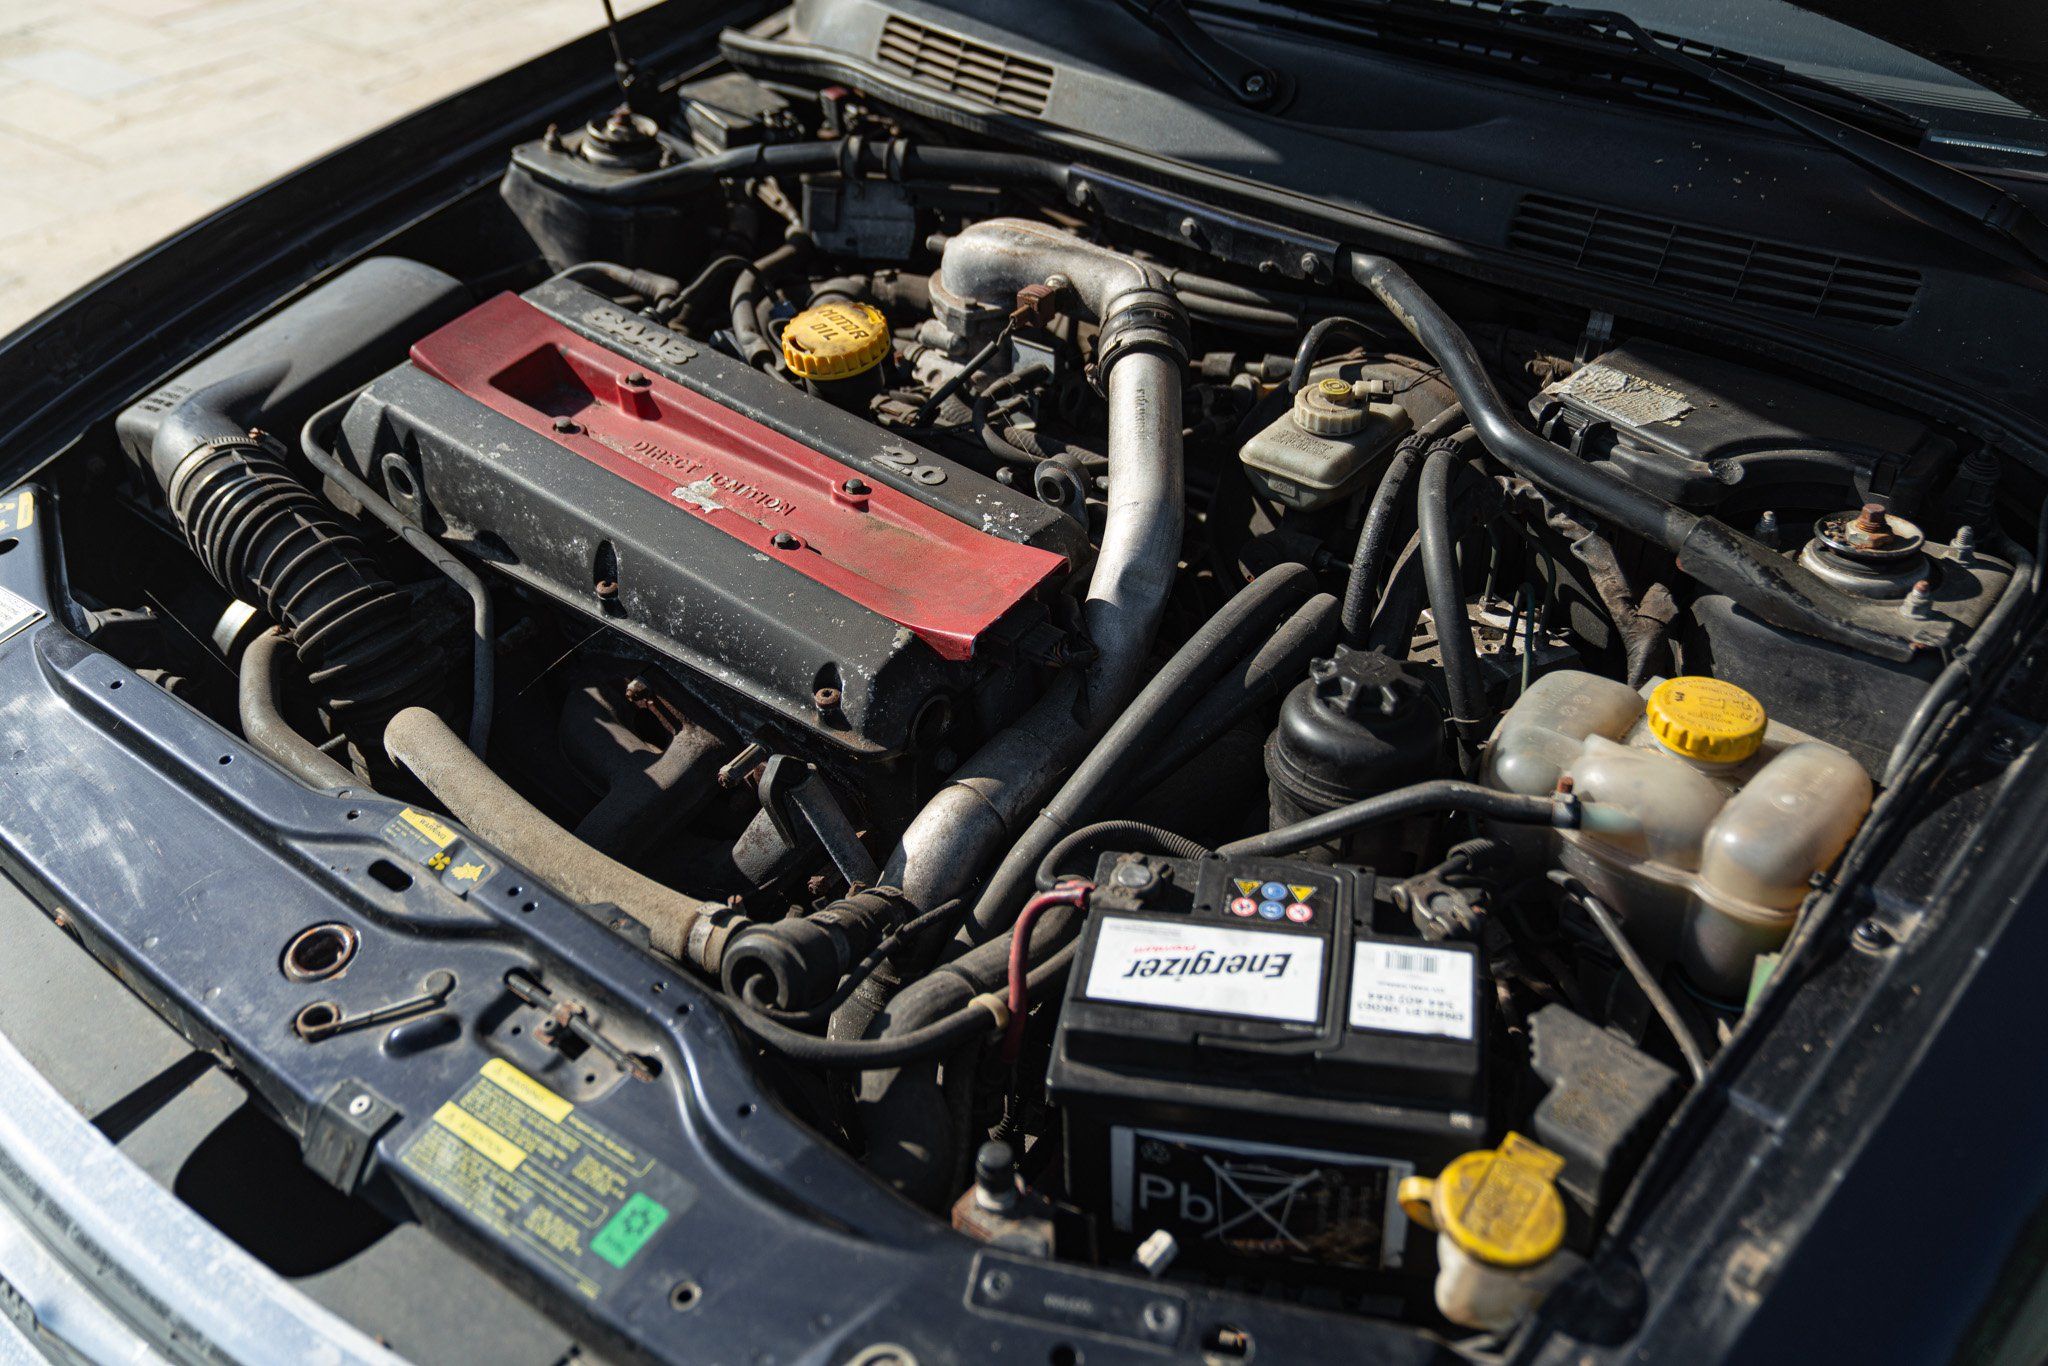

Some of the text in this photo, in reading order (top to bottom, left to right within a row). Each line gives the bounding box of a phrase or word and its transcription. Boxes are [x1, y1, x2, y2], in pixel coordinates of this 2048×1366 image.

[582, 306, 699, 365] SAAB
[810, 322, 839, 341] OIL
[817, 308, 870, 340] MOTOR
[634, 441, 798, 517] DIRECT IGNITION
[871, 446, 948, 486] 2.0
[1122, 950, 1293, 982] Energizer
[1138, 1173, 1215, 1224] Pb
